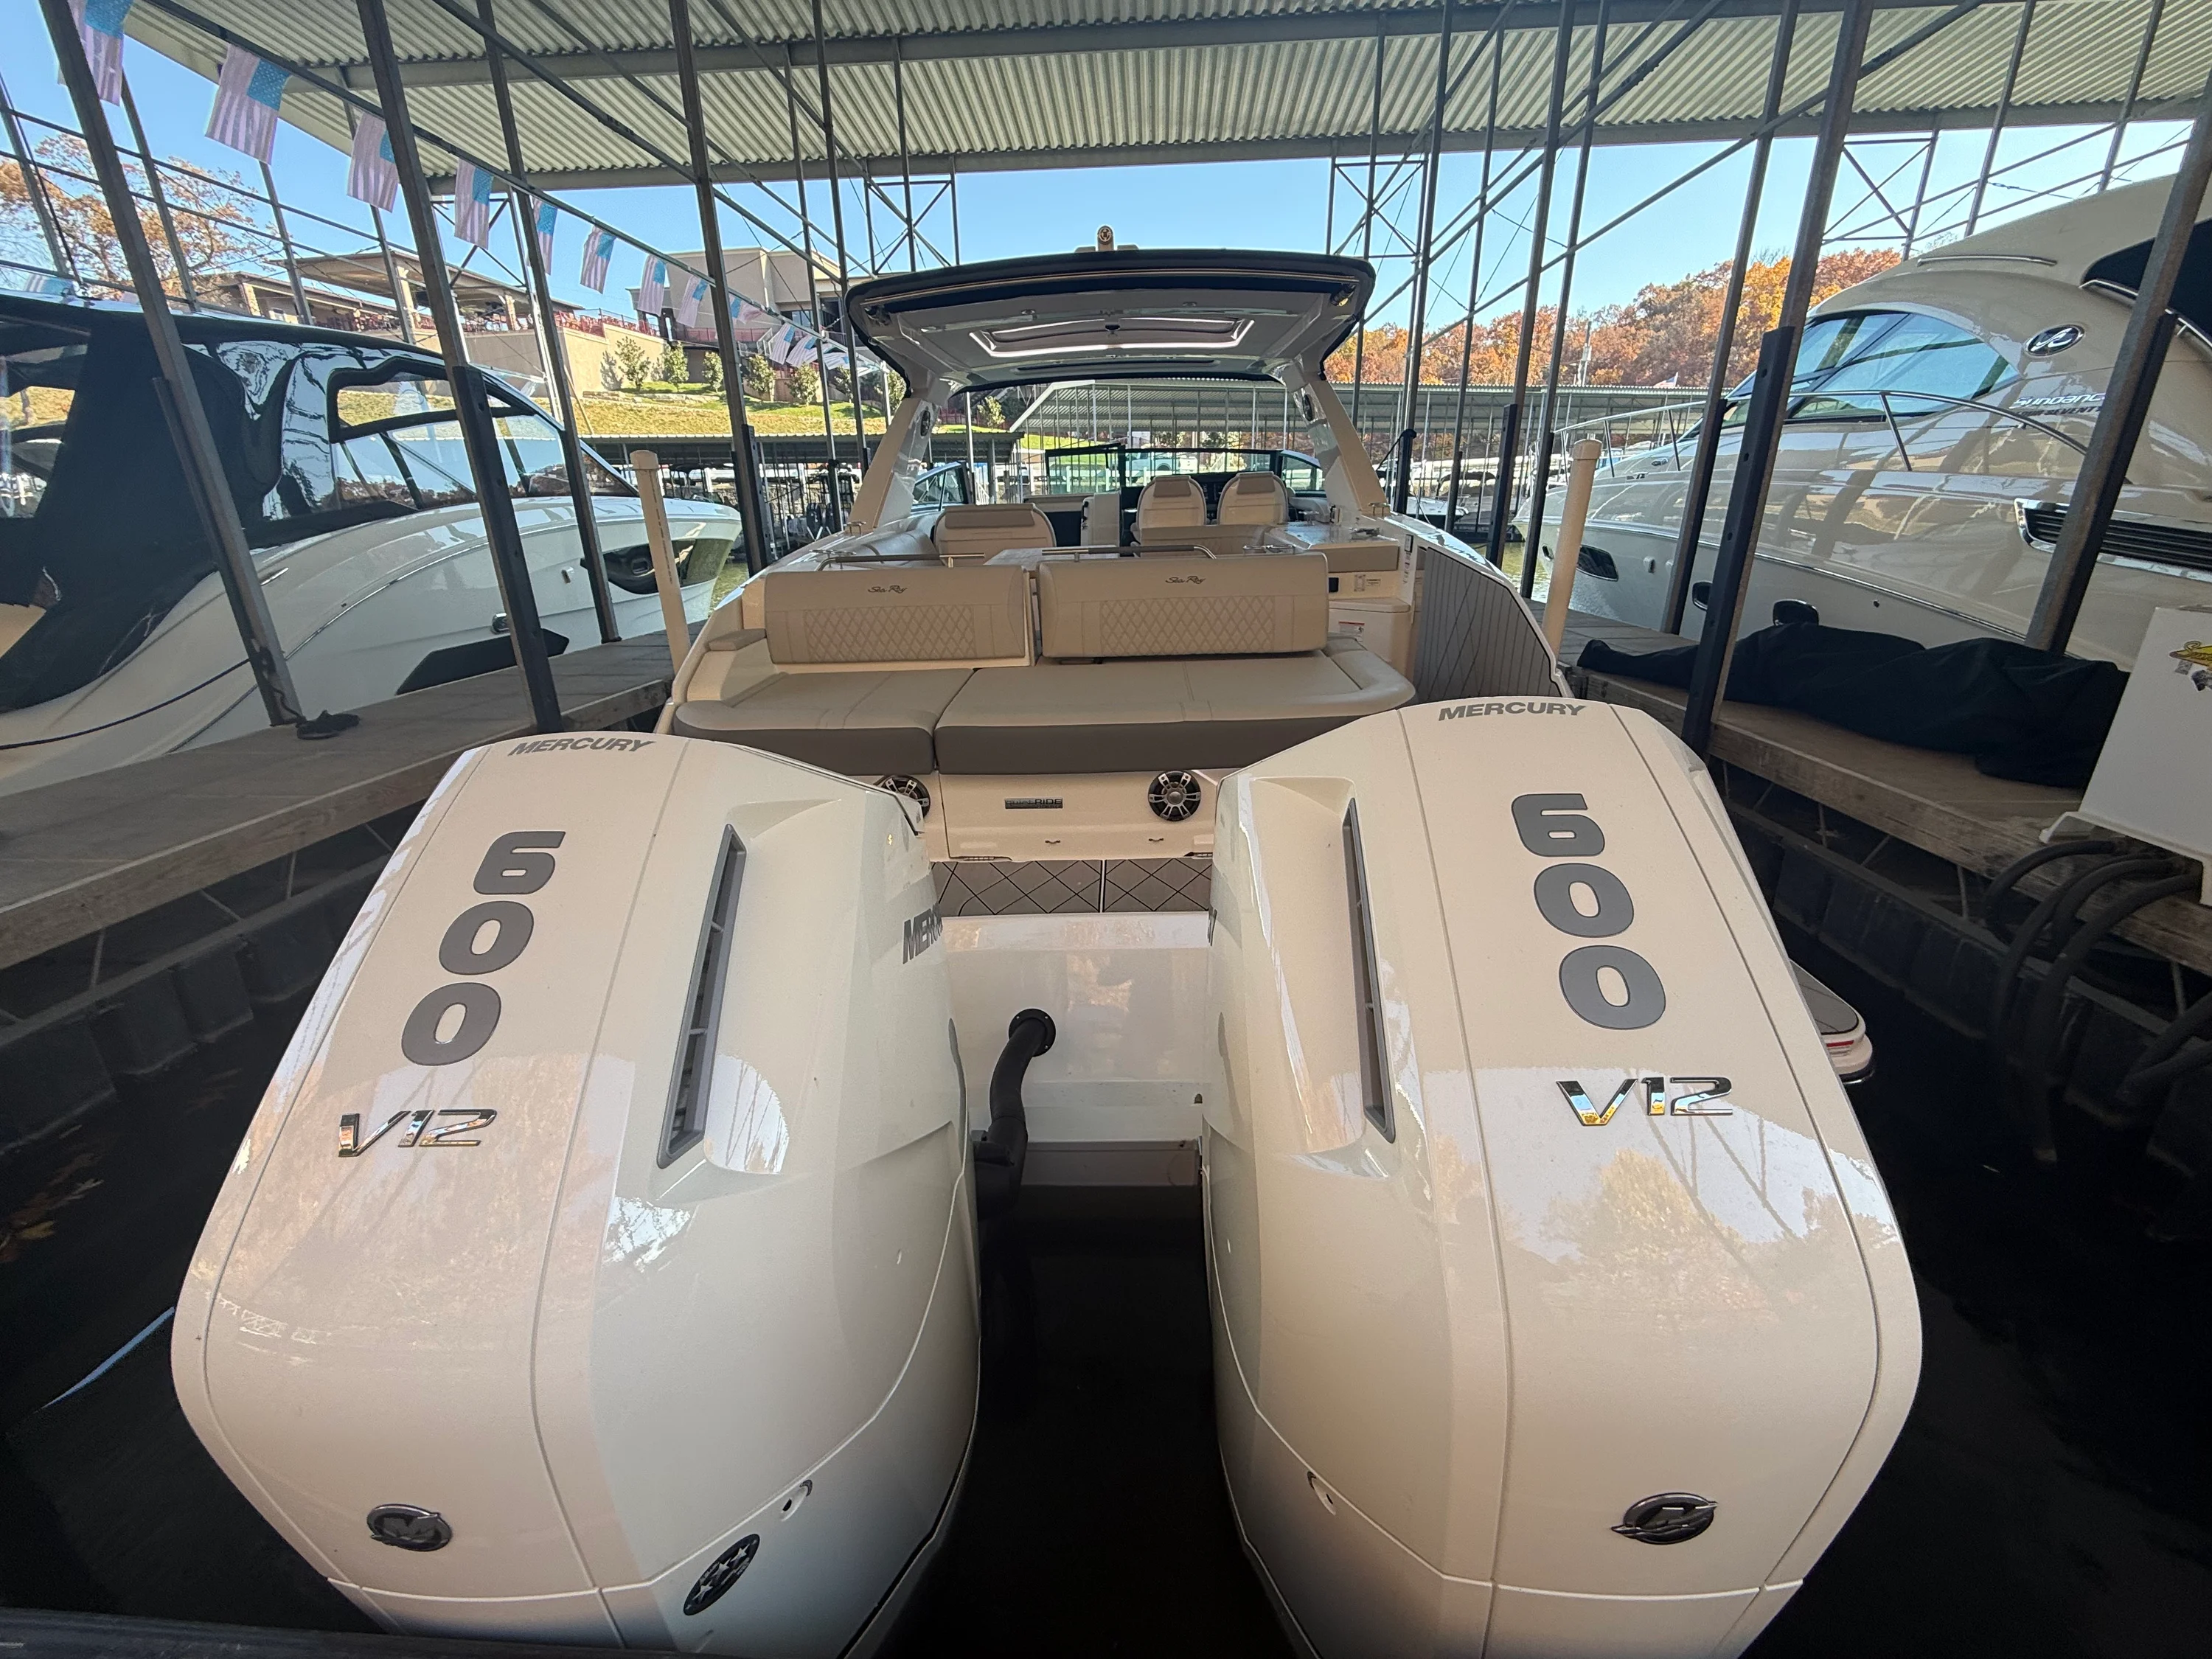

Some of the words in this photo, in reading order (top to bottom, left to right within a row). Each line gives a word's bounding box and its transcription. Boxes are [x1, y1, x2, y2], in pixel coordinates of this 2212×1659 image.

[1186, 575, 1206, 584] Ray
[1439, 702, 1587, 721] MERCURY
[507, 737, 656, 757] MERCURY
[1511, 793, 1666, 1031] 600
[401, 831, 566, 1067] 600
[1556, 1077, 1733, 1126] V12
[338, 1109, 498, 1158] V12
